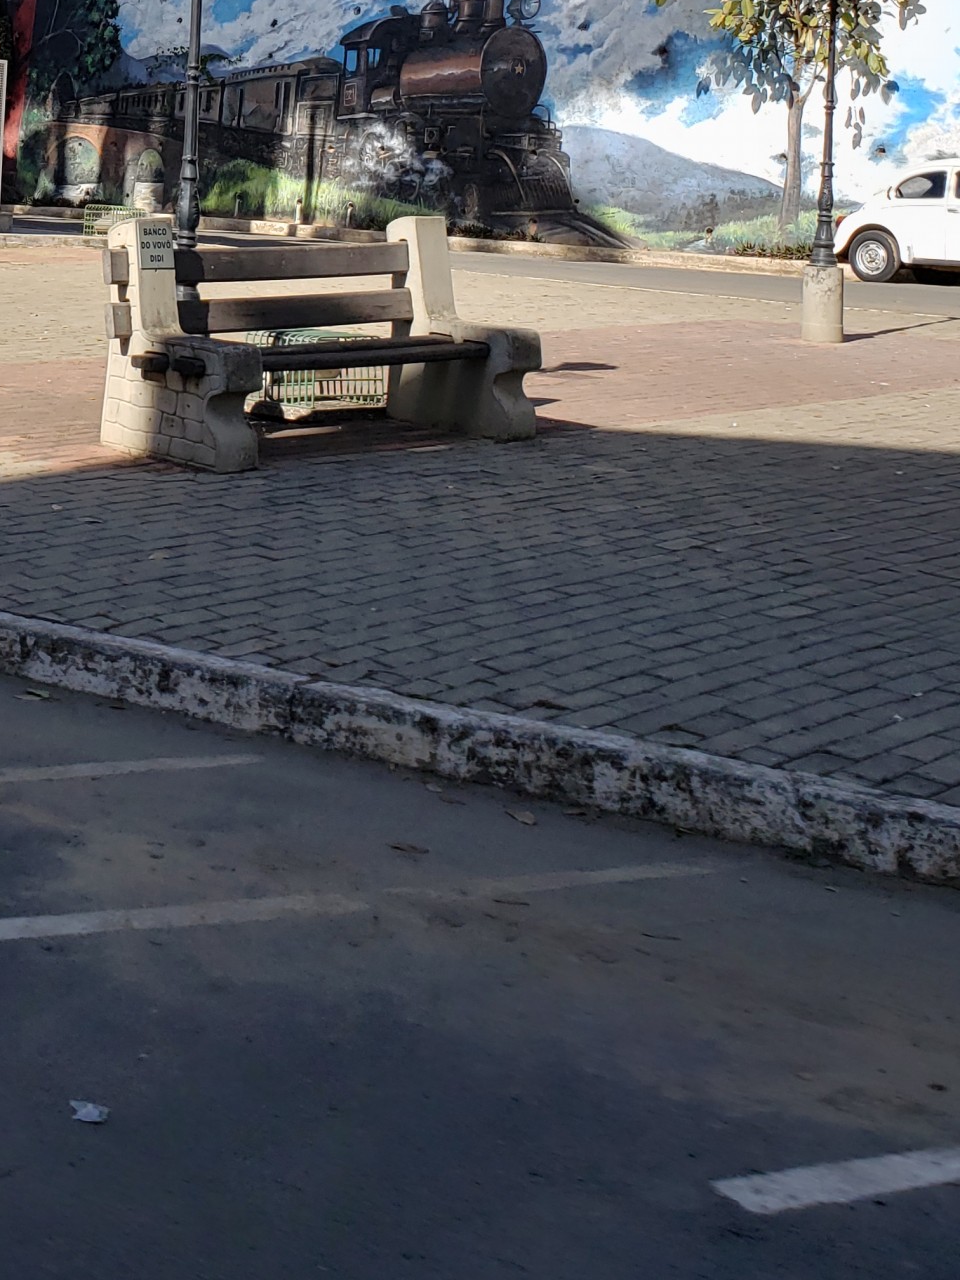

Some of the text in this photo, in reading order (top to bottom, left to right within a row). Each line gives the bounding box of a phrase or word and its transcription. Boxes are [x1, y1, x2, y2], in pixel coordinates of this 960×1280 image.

[143, 228, 167, 236] BANCO
[141, 241, 151, 249] DO
[150, 254, 164, 262] DIDI
